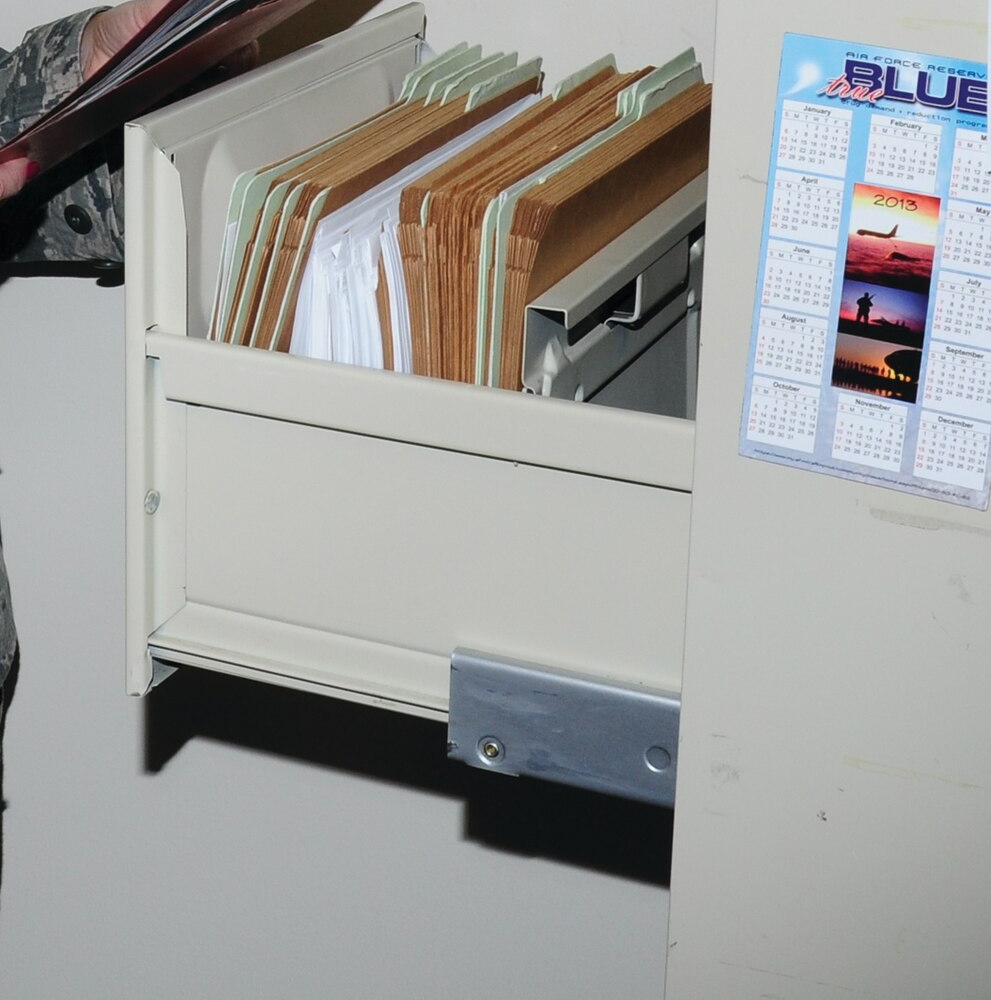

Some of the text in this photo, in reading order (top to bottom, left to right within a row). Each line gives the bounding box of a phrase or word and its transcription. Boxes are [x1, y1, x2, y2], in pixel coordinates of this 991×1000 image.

[845, 51, 986, 80] AIR FORCE RESERV
[818, 74, 884, 103] true
[845, 59, 987, 114] BLUE
[803, 104, 831, 116] January
[889, 118, 922, 131] February
[801, 175, 818, 185] April
[873, 192, 918, 212] 2013
[975, 206, 990, 216] May
[793, 245, 810, 254] June
[966, 277, 982, 288] July
[781, 313, 806, 325] August
[945, 345, 984, 360] September
[772, 381, 800, 393] October
[854, 398, 891, 411] November
[937, 415, 974, 429] December
